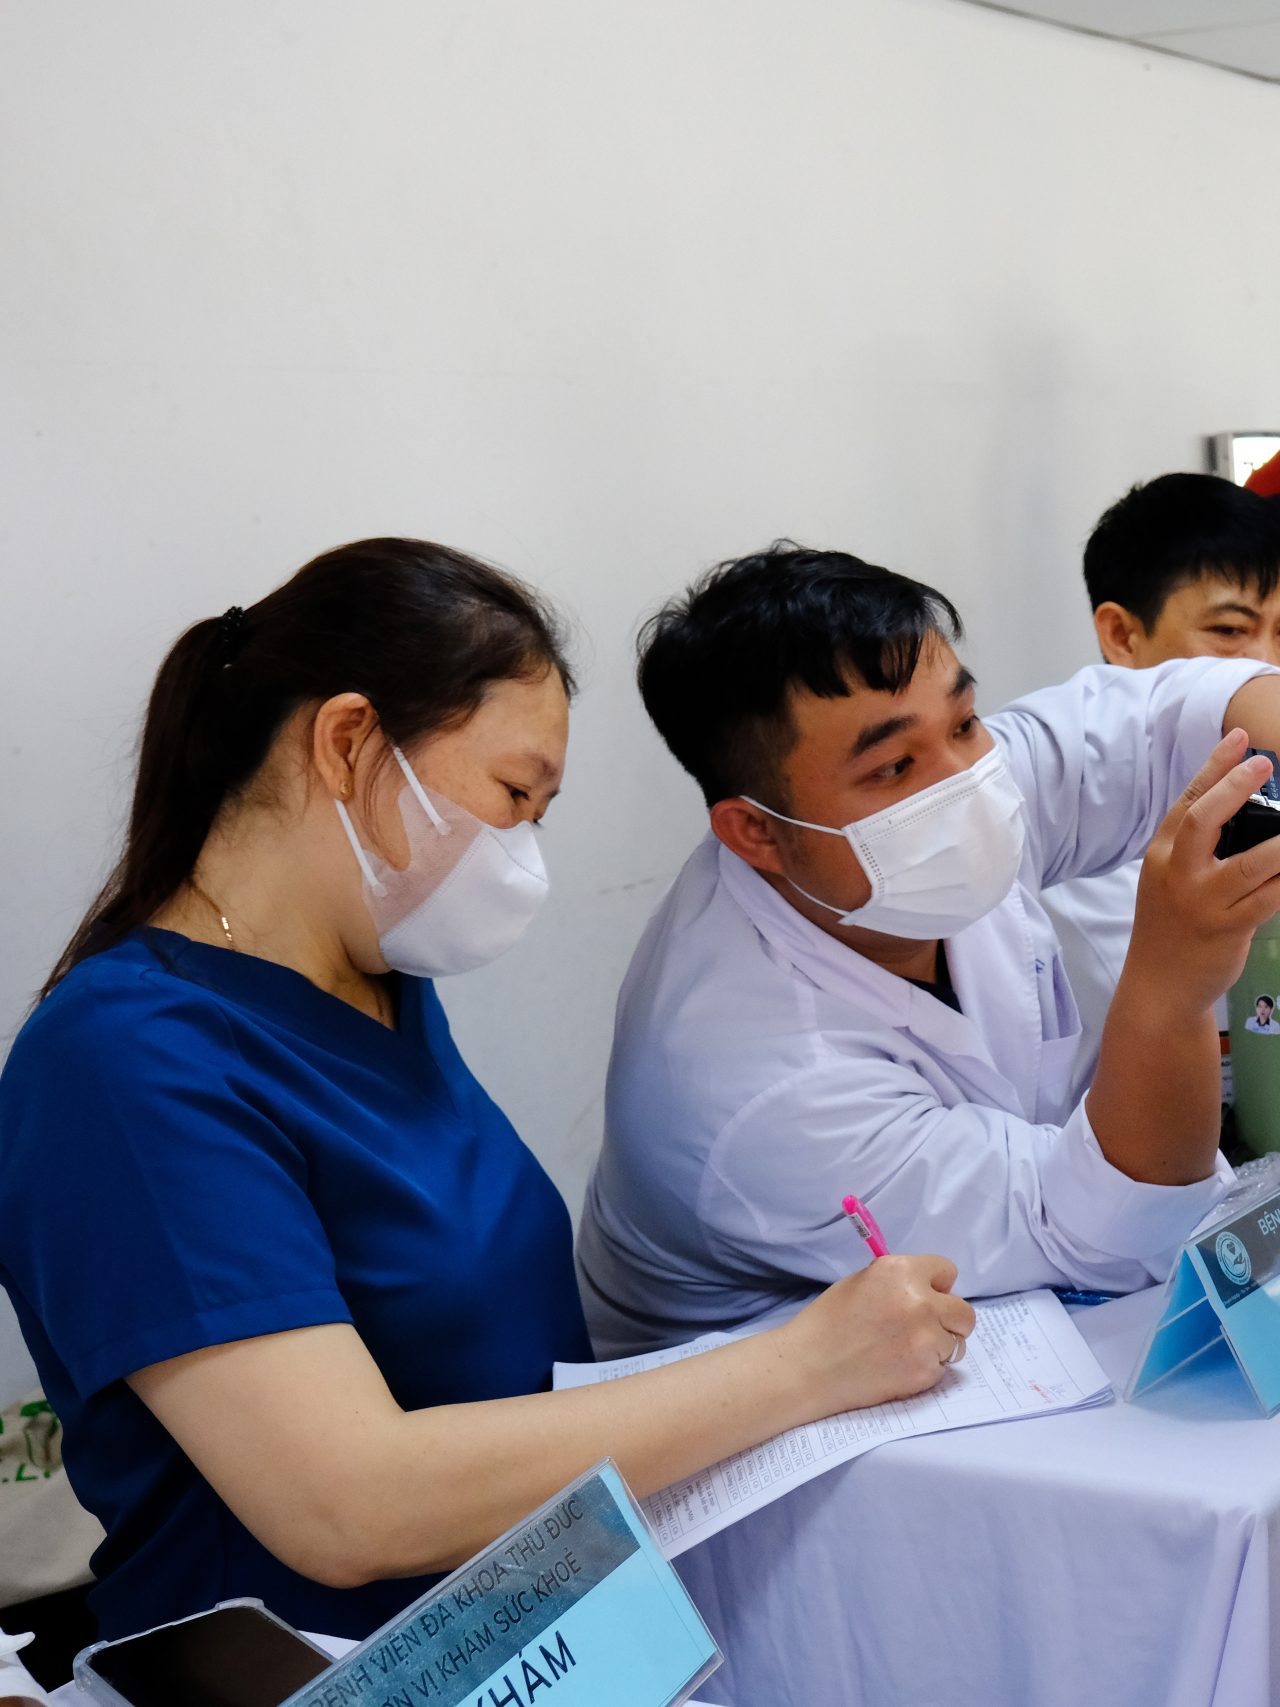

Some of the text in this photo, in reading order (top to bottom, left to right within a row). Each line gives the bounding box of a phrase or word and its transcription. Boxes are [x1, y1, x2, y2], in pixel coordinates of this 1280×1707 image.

[369, 1626, 422, 1674] VIỆN
[420, 1603, 455, 1638] ĐA
[452, 1560, 510, 1613] KHOA
[504, 1527, 545, 1567] THỦ
[543, 1499, 584, 1540] ĐỨC
[410, 1669, 441, 1698] VỊ
[435, 1622, 495, 1682] KHÁM
[493, 1590, 534, 1633] SỨC
[477, 1630, 576, 1707] HÁM
